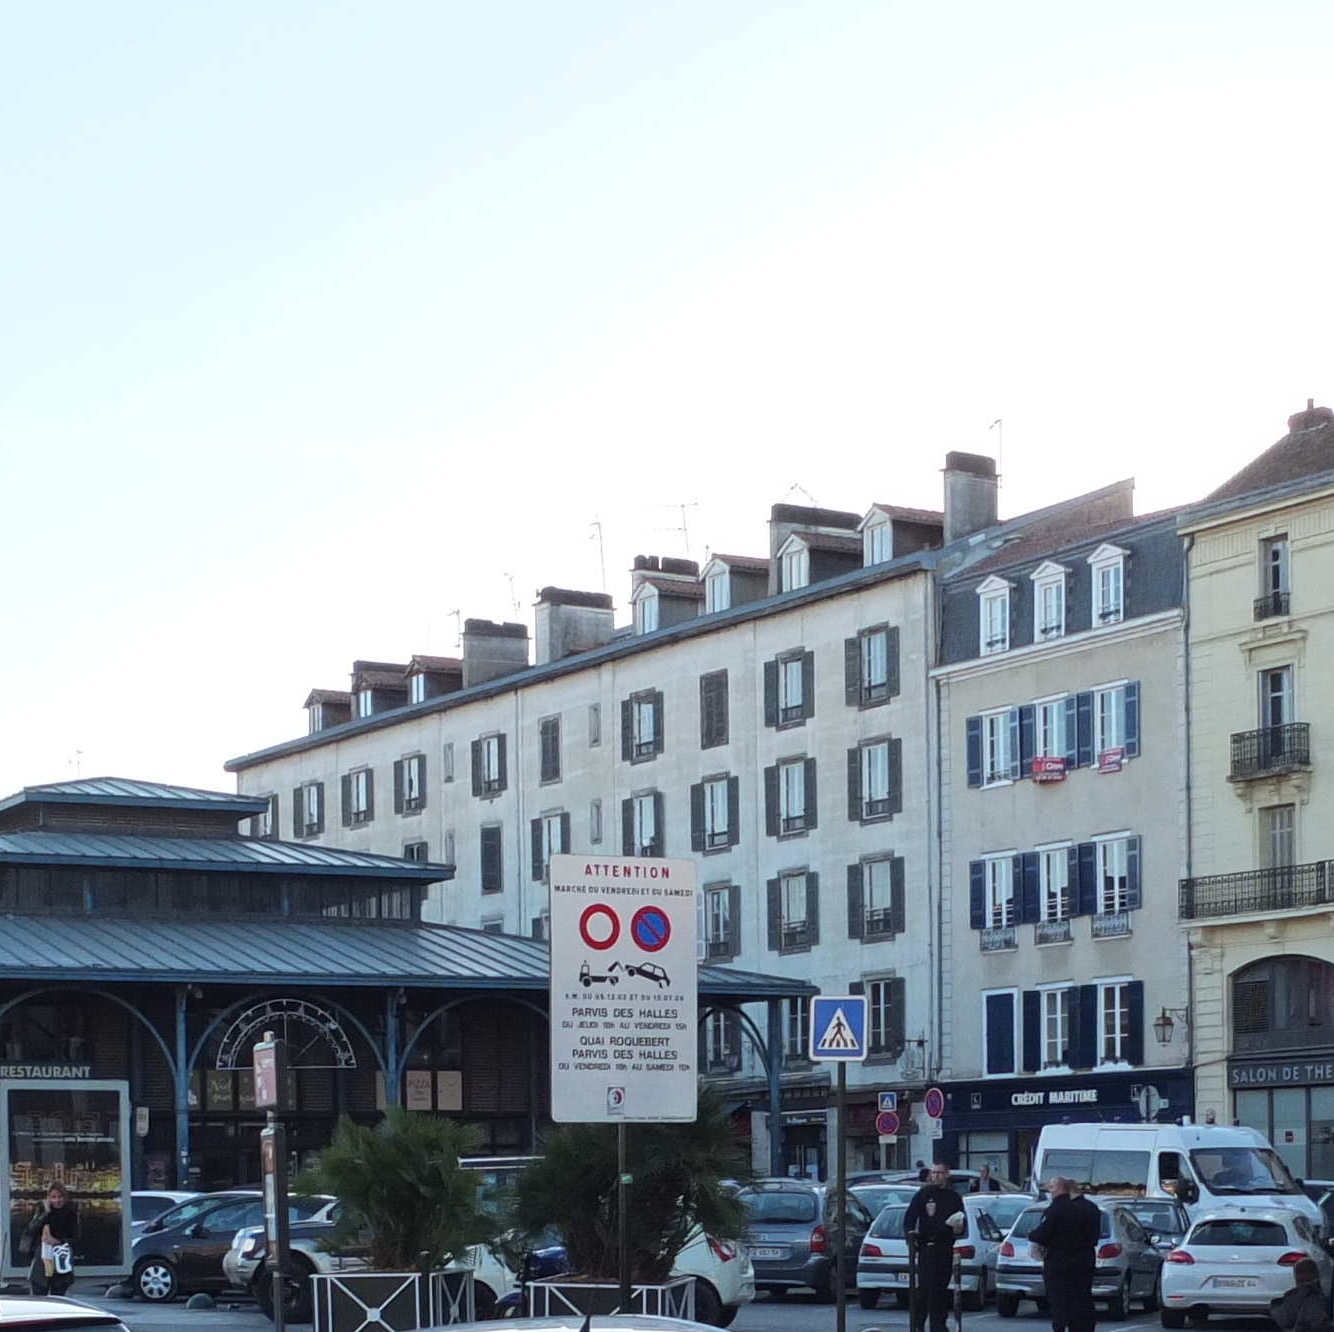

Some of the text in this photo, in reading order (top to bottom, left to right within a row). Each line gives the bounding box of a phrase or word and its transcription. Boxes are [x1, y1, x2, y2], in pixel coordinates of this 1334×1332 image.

[584, 864, 670, 879] ATTENTION
[554, 884, 693, 897] MARCHÉ DU VENDREDI ET DU SAMEDI
[572, 1007, 678, 1019] PARVIS DES HALLES
[562, 1021, 573, 1029] DU
[577, 1021, 599, 1029] JEUDI
[634, 1022, 671, 1030] VENDREDI
[580, 1036, 670, 1047] QUAI ROQUEBERT
[572, 1049, 678, 1060] PARVIS DES HALLES
[0, 1065, 91, 1079] RESTAURANT
[558, 1062, 570, 1070] DU
[574, 1063, 611, 1071] VENDREDI
[632, 1063, 642, 1071] AU
[646, 1063, 674, 1071] SAMEDI
[1232, 1064, 1333, 1084] SALON DE THE
[1011, 1089, 1098, 1106] CRÉDIT MARITIME
